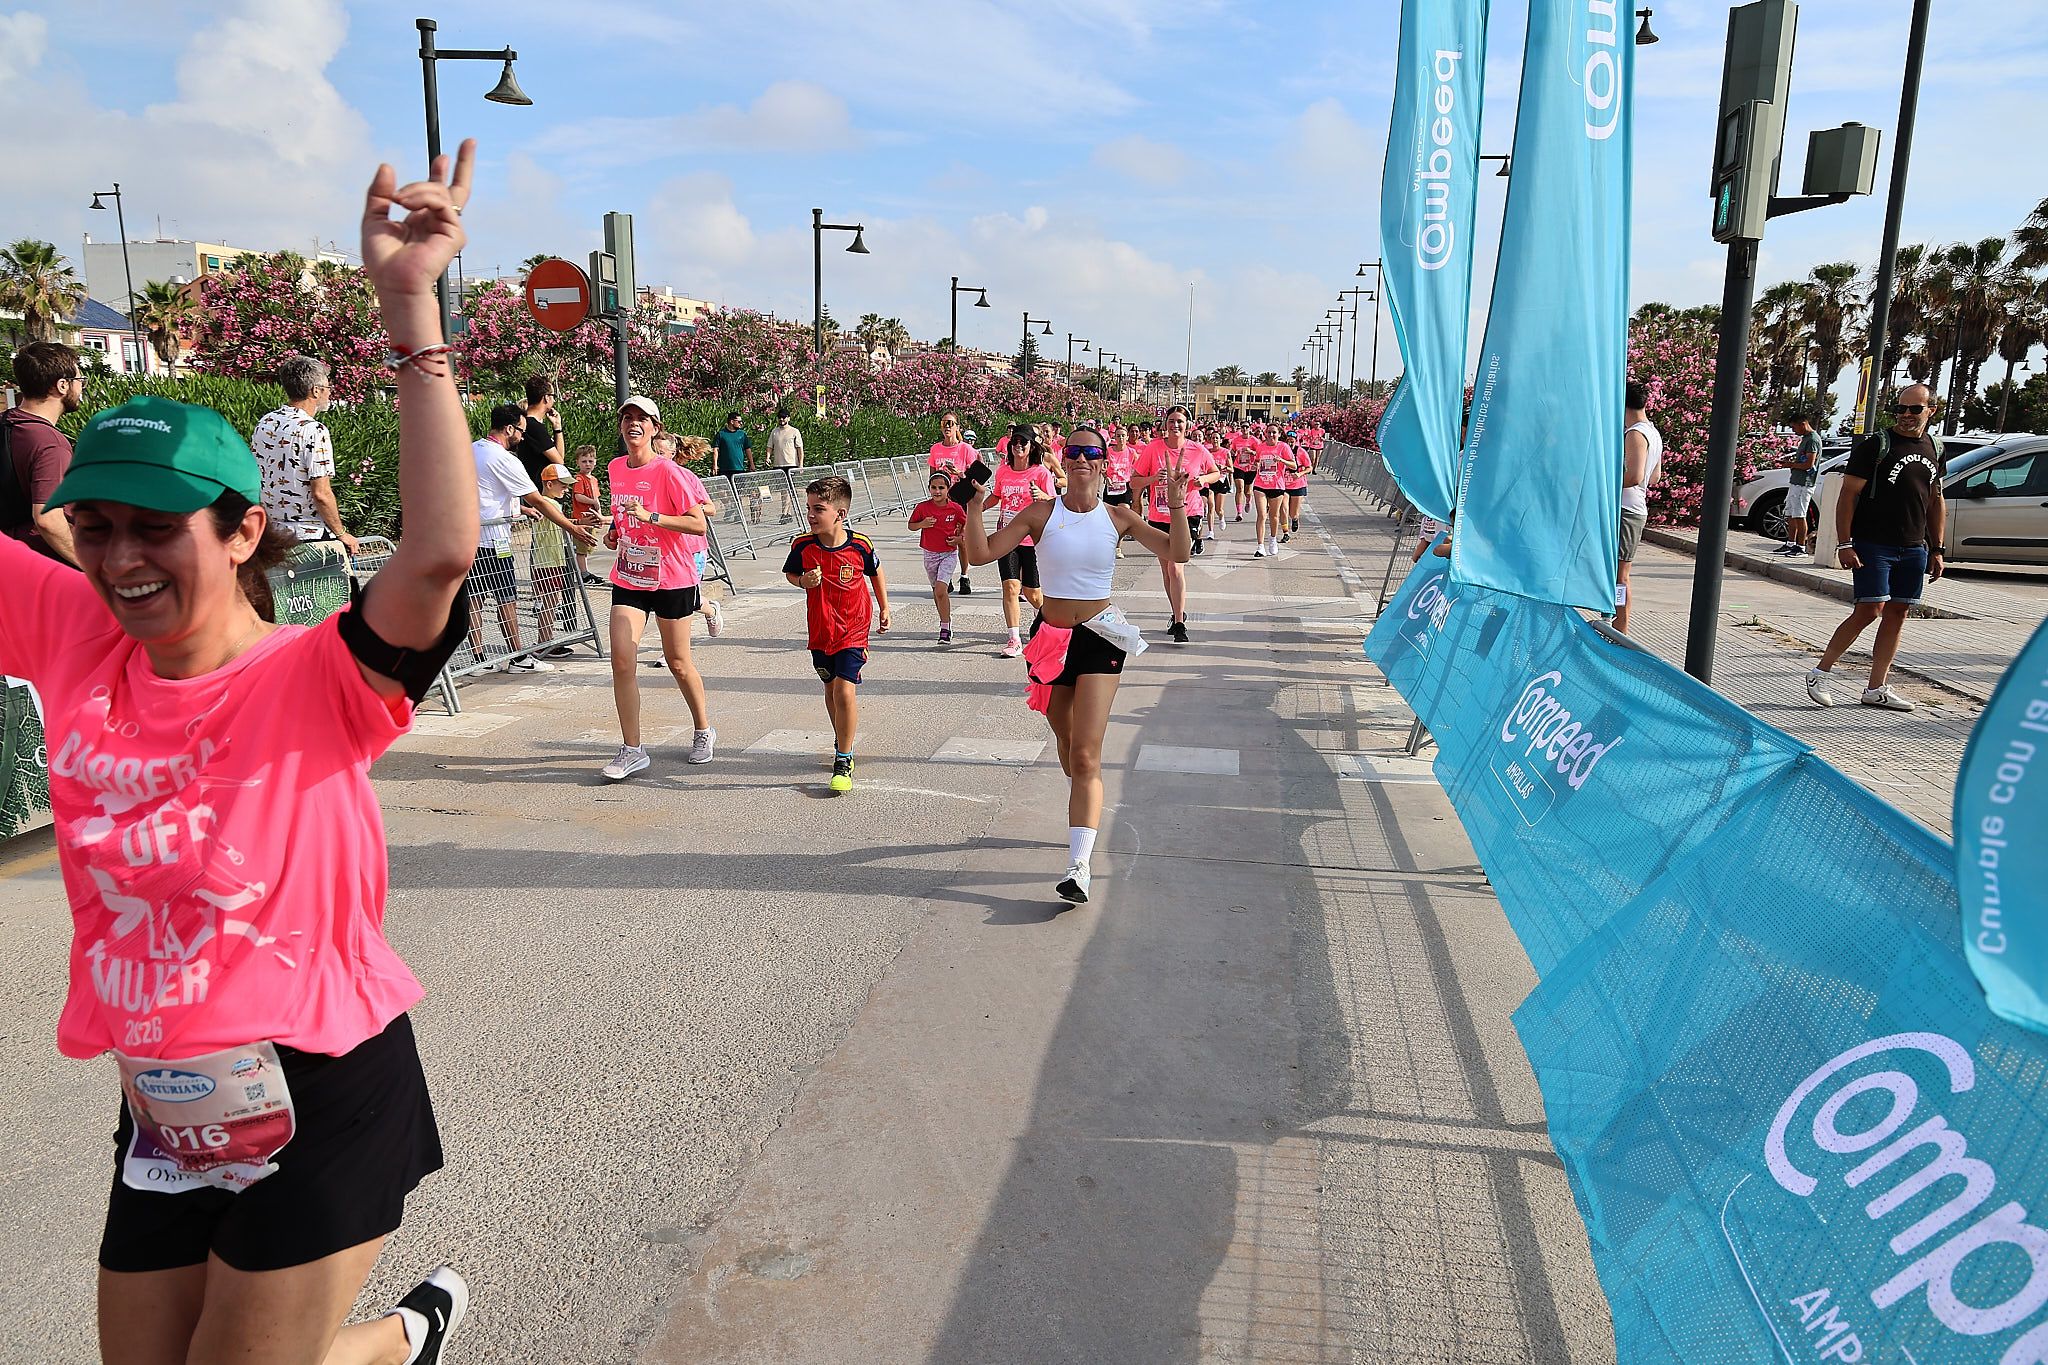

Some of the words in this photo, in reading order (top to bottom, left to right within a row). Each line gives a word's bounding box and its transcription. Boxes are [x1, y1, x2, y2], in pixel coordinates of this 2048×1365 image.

[1887, 462, 1904, 485] ARE
[1899, 453, 1922, 466] YOU
[627, 562, 646, 573] 016
[286, 594, 314, 614] 2026
[1501, 670, 1622, 791] Compeed
[1505, 760, 1536, 800] AMPOLLAS
[91, 951, 211, 1016] MUJER
[159, 1123, 232, 1150] 016
